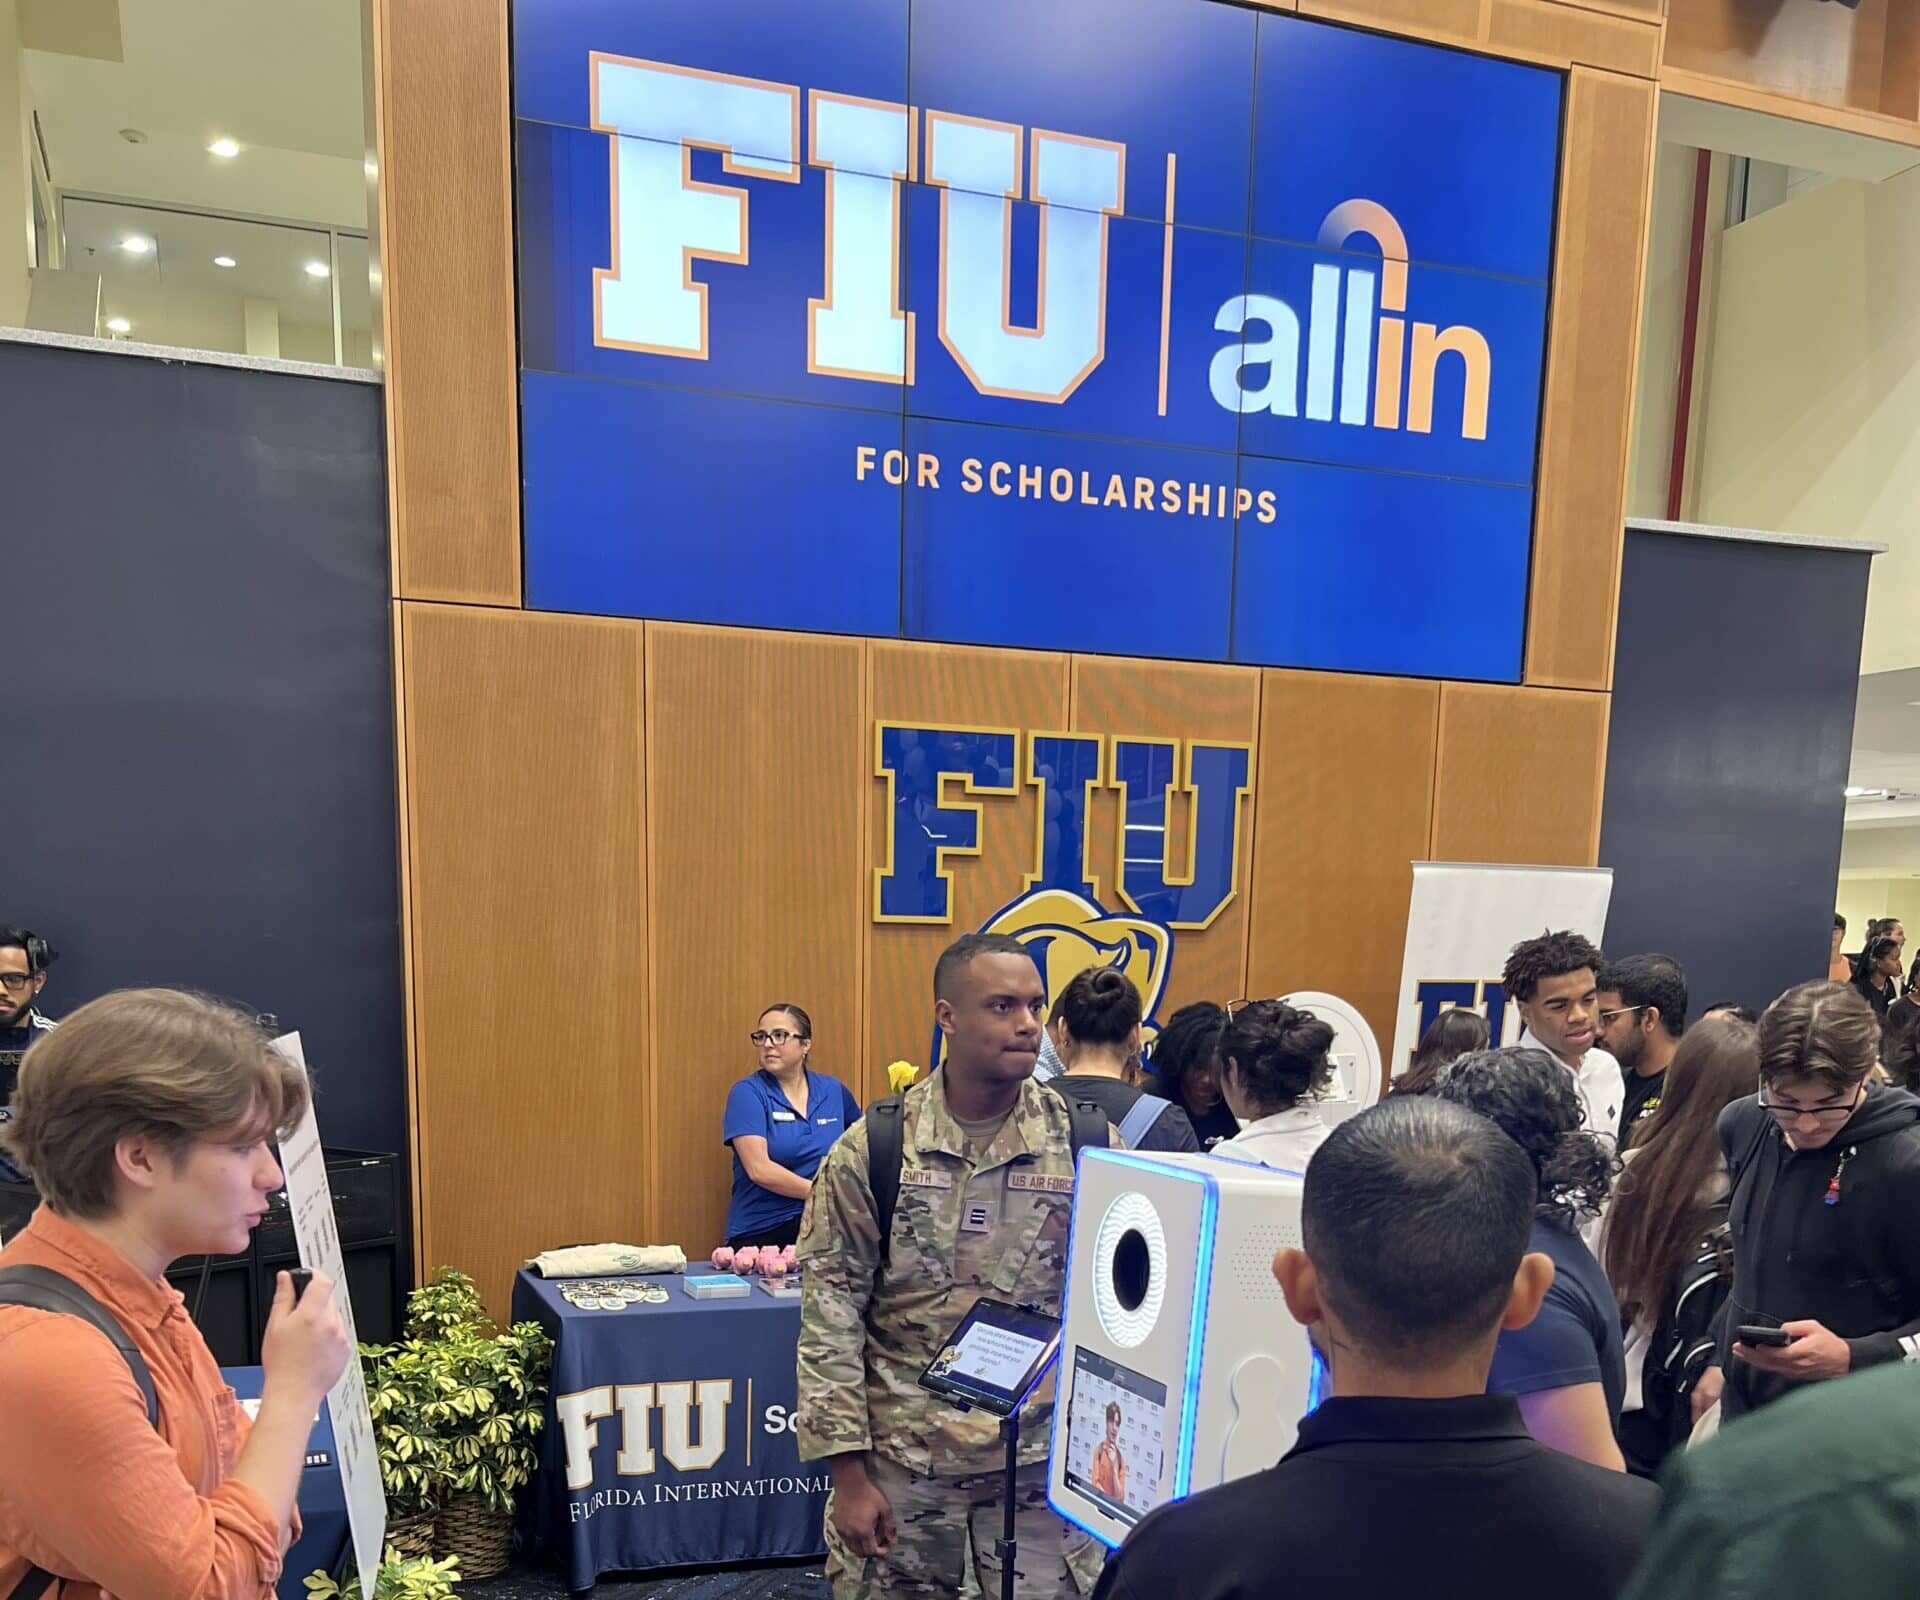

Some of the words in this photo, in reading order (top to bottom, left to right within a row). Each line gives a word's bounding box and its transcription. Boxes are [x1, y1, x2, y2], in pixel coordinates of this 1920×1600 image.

[589, 51, 1125, 404] FIU
[856, 446, 940, 489] FOR
[961, 458, 1277, 524] SCHOLARSHIPS
[873, 720, 1254, 930] FIU
[902, 1171, 932, 1185] SMITH
[1029, 1176, 1045, 1189] AIR
[1047, 1178, 1075, 1192] FORCE
[556, 1379, 732, 1490] FIU
[569, 1489, 647, 1523] FLORIDA
[653, 1475, 834, 1503] INTERNATIONAL
